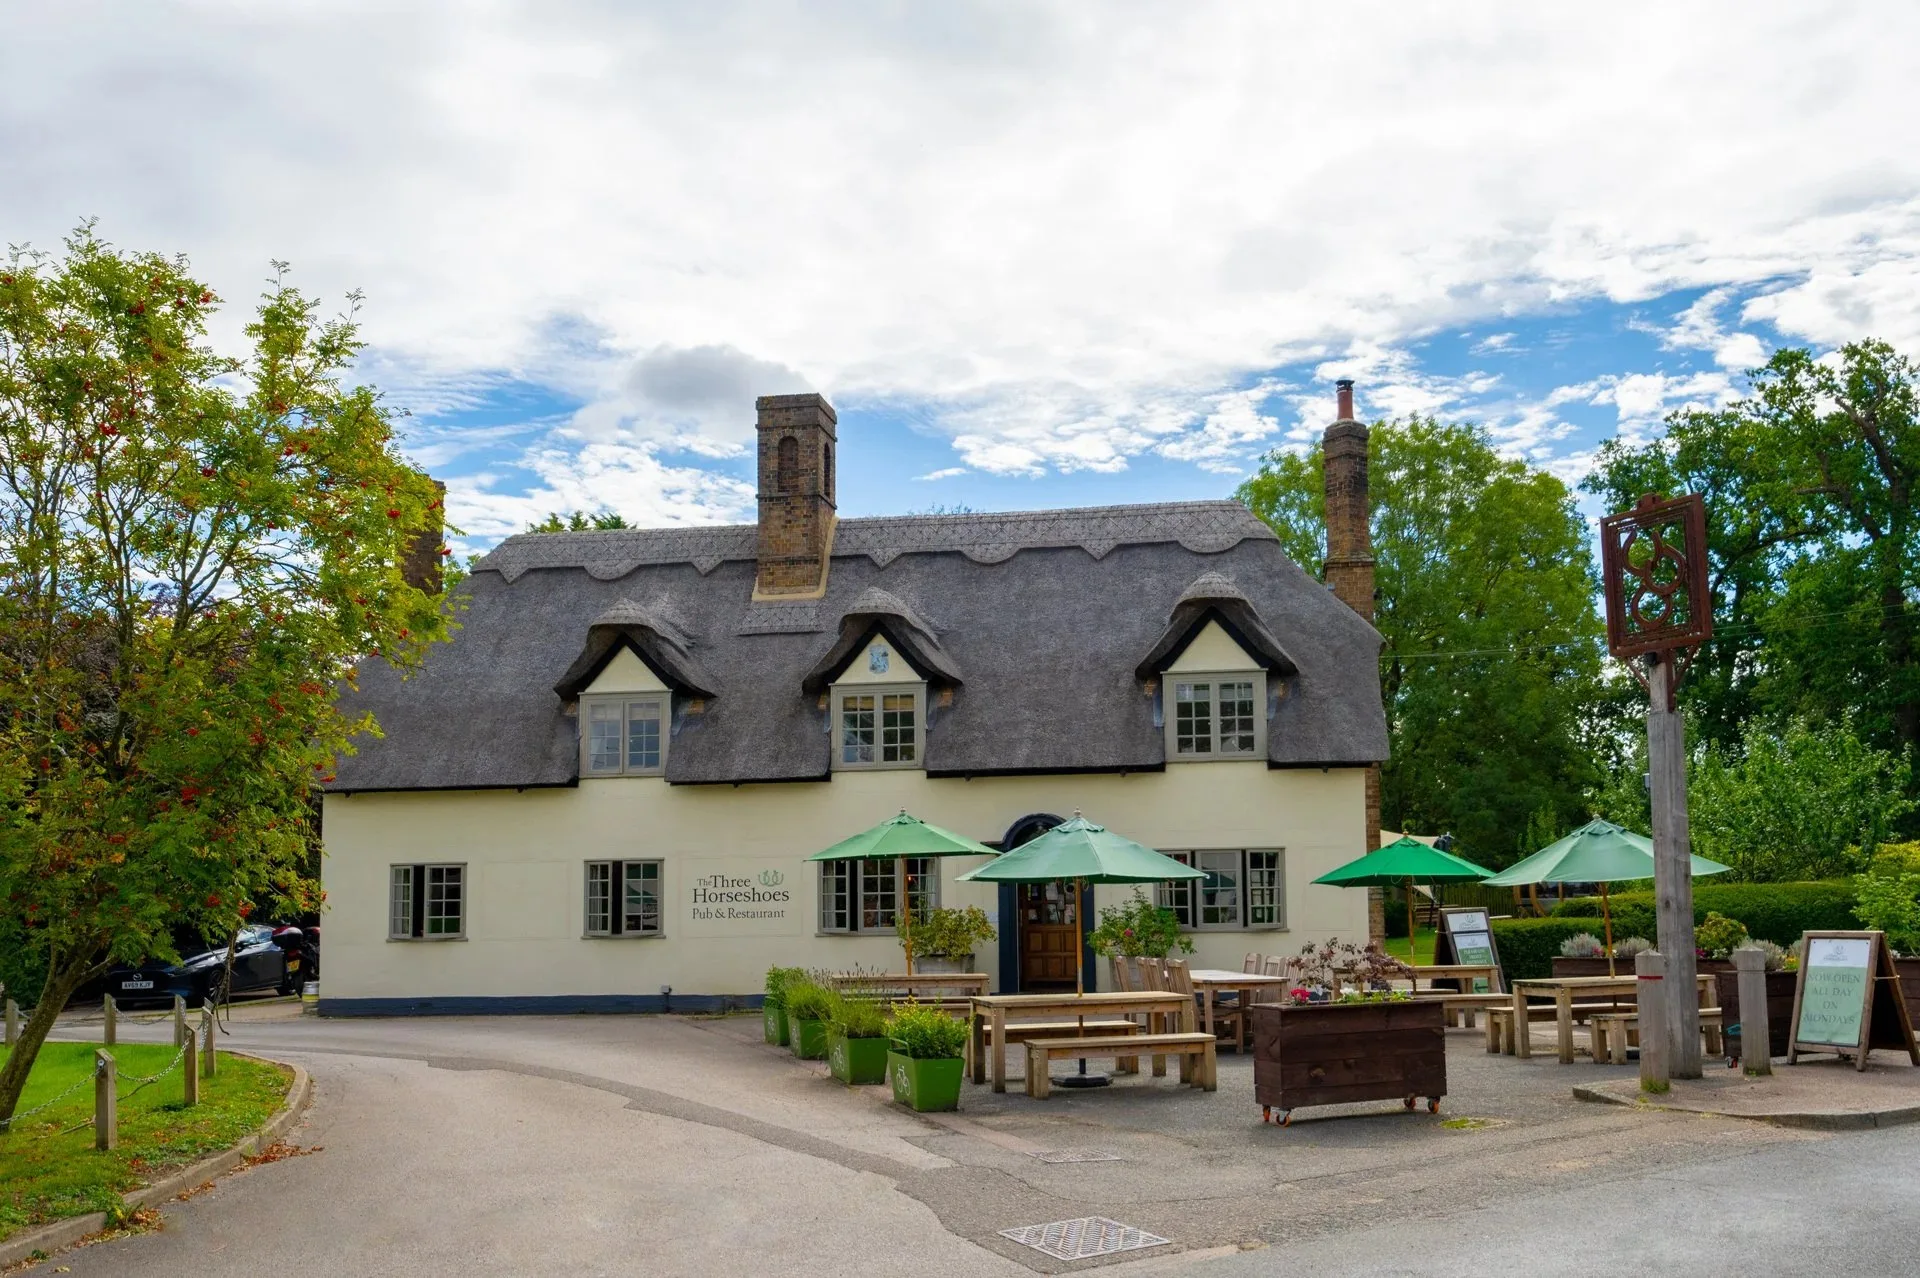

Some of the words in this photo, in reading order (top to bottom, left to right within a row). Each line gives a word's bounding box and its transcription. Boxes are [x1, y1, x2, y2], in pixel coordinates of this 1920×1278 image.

[697, 878, 712, 886] The
[710, 874, 751, 888] Three
[692, 887, 790, 903] Horseshoes
[692, 907, 713, 919] Pub
[714, 908, 726, 918] &
[728, 907, 785, 919] Restaurant
[1807, 972, 1832, 982] NOW
[1833, 973, 1861, 983] OPEN
[1812, 987, 1829, 996] ALL
[1832, 987, 1854, 997] DAY
[1823, 1000, 1838, 1010] ON
[1803, 1012, 1855, 1025] MONDAYS
